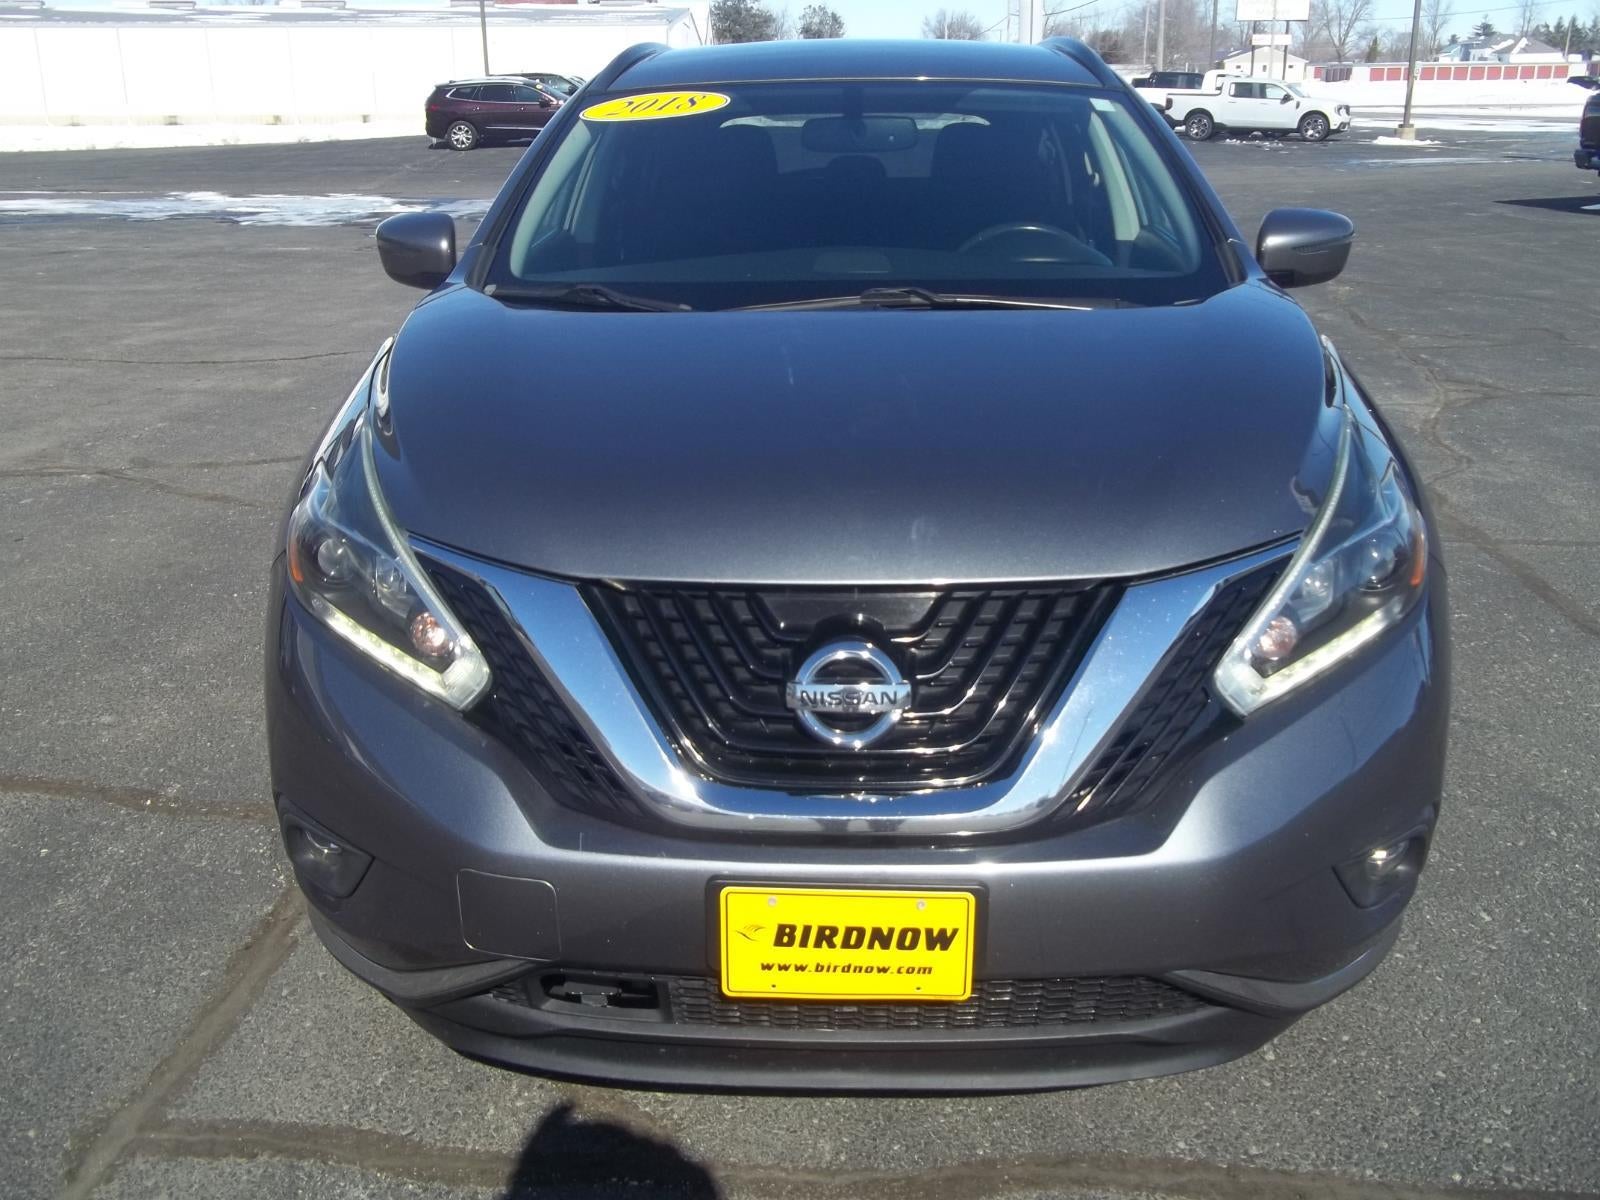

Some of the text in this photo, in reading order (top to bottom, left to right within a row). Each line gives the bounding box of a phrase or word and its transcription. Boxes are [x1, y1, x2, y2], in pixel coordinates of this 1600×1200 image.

[606, 95, 707, 116] 2018
[800, 690, 898, 707] NISSAN
[773, 923, 959, 951] BIRDNOW
[760, 962, 933, 975] www.birdnow.com
